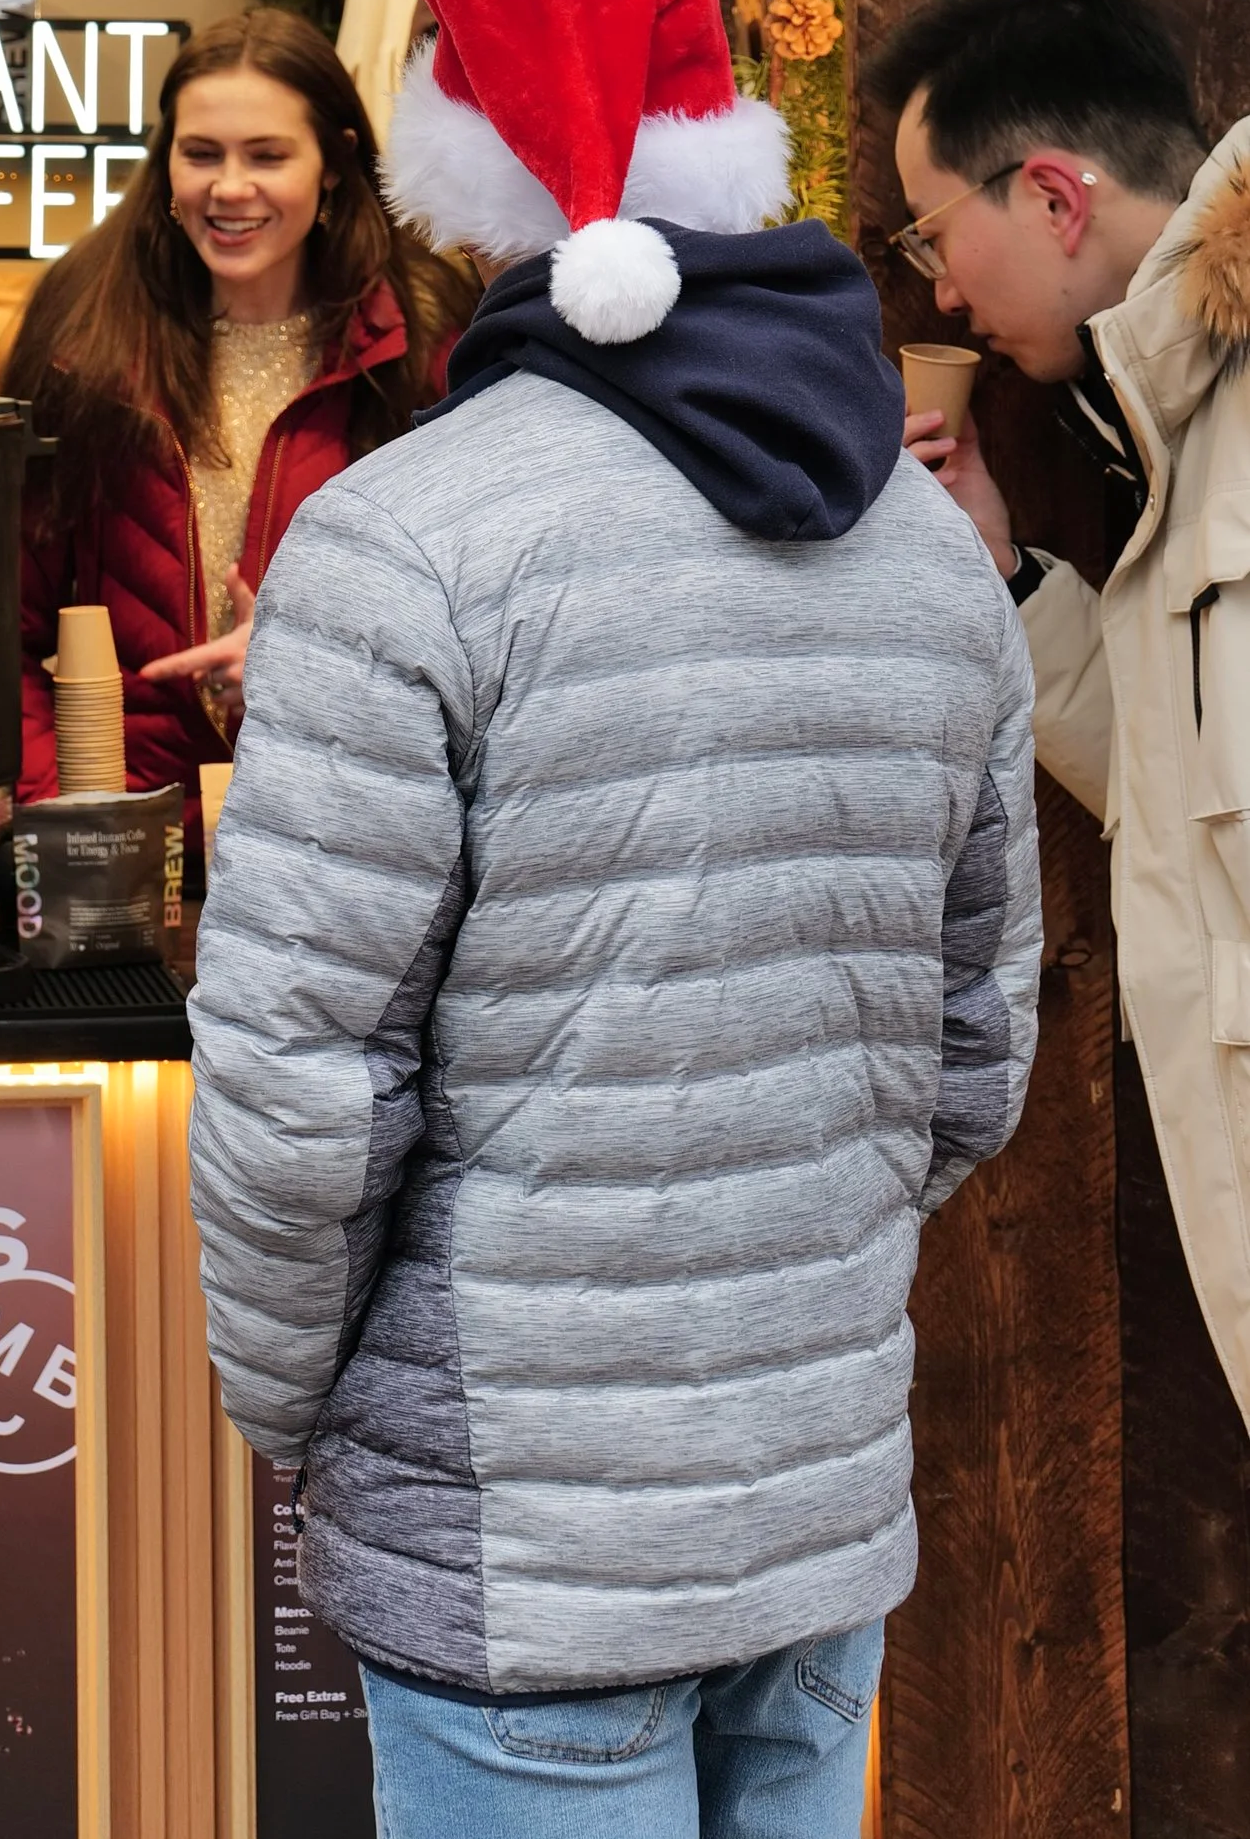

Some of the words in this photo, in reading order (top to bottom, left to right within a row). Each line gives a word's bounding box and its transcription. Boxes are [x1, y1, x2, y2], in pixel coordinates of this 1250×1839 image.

[164, 822, 184, 928] BREW.
[13, 833, 43, 939] MOOD
[274, 1625, 310, 1636] Beanie
[274, 1643, 297, 1654] Tote
[274, 1660, 312, 1671] Hoodie
[275, 1691, 305, 1704] Free
[306, 1690, 347, 1703] Extras
[275, 1710, 299, 1722] Free
[299, 1709, 319, 1721] Gift
[319, 1708, 341, 1723] Bag
